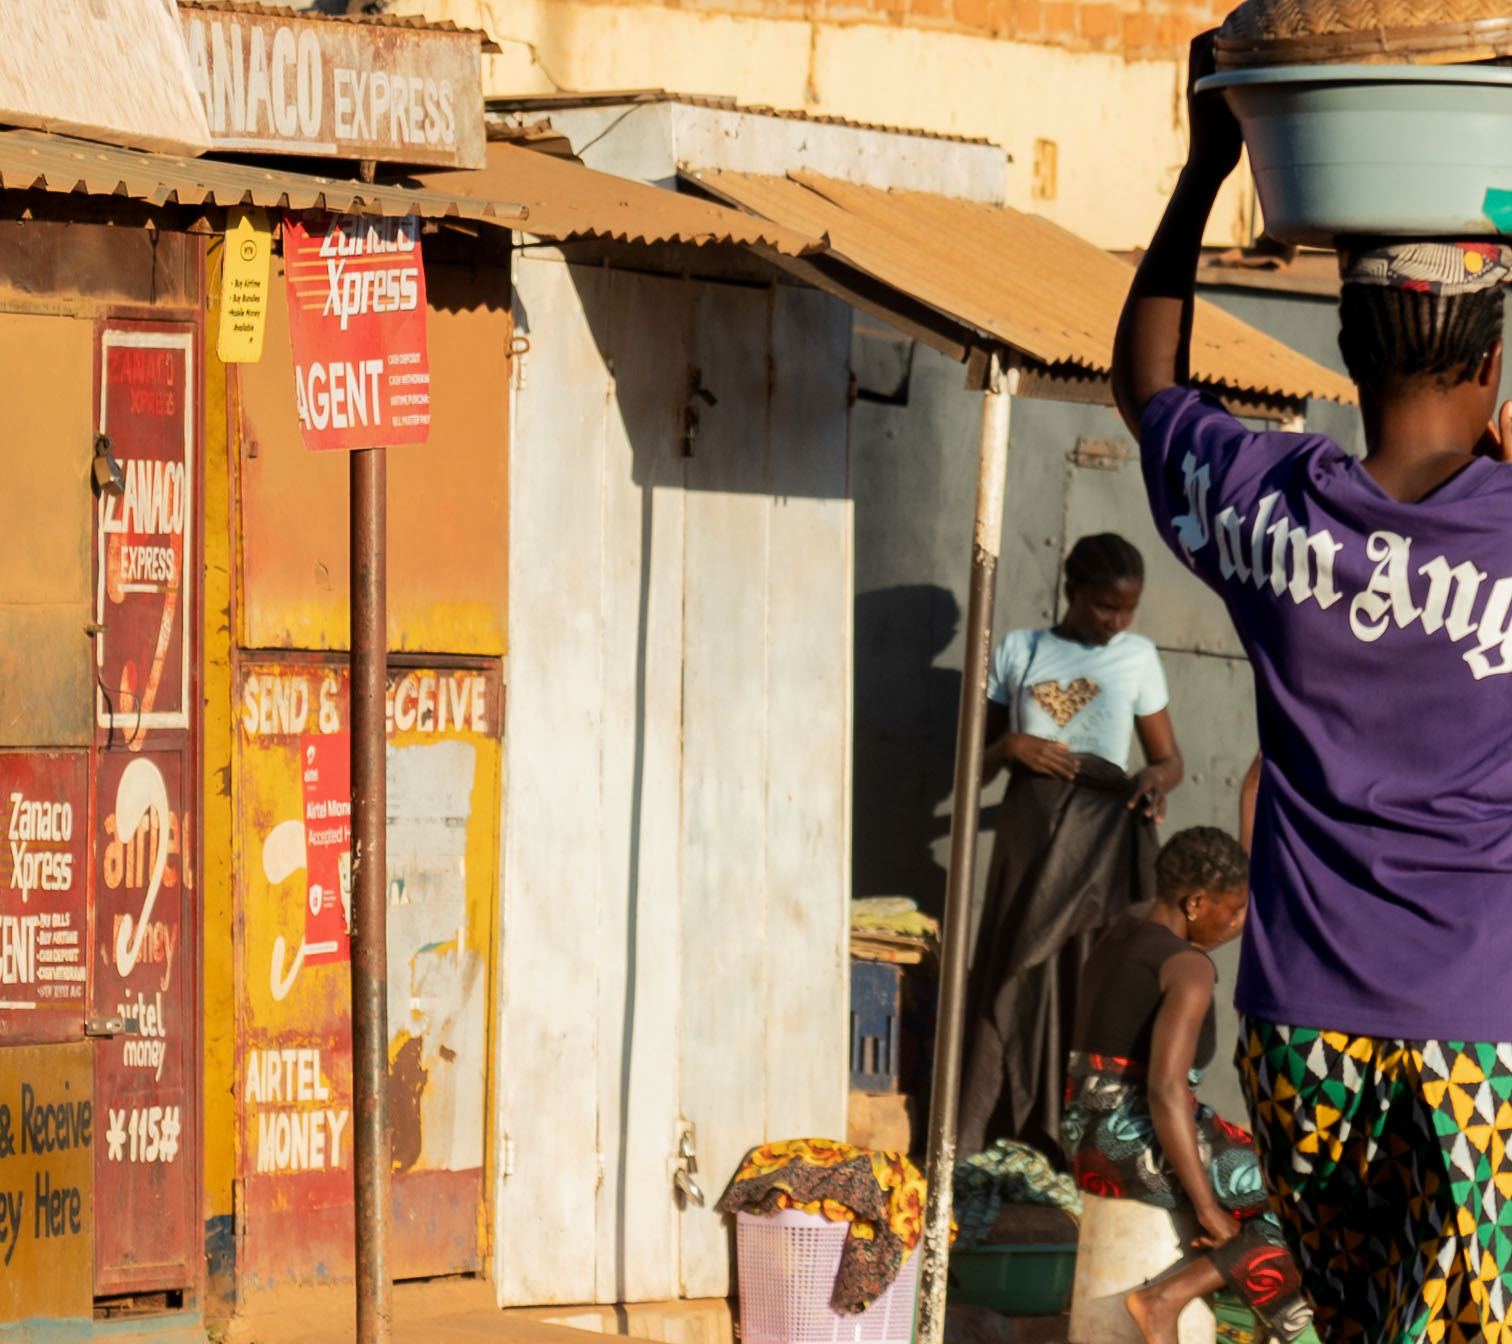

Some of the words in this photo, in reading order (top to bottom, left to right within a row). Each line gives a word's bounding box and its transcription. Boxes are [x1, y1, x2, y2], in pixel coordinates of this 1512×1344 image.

[187, 19, 323, 139] ANACO
[334, 68, 455, 145] EXPRESS
[322, 258, 418, 331] Xpress
[296, 359, 384, 431] AGENT
[103, 459, 185, 535] ZANACO
[120, 546, 175, 581] EXPRESS
[1171, 451, 1344, 610] Palm
[244, 676, 308, 734] SEND
[319, 678, 339, 734] &
[387, 676, 488, 733] CEIVE
[8, 792, 73, 842] Zanaco
[9, 840, 73, 903] Xpress
[123, 1039, 166, 1082] money
[245, 1048, 329, 1103] AIRTEL
[21, 1081, 93, 1156] Receive
[257, 1109, 349, 1173] MONEY
[34, 1171, 82, 1239] Here
